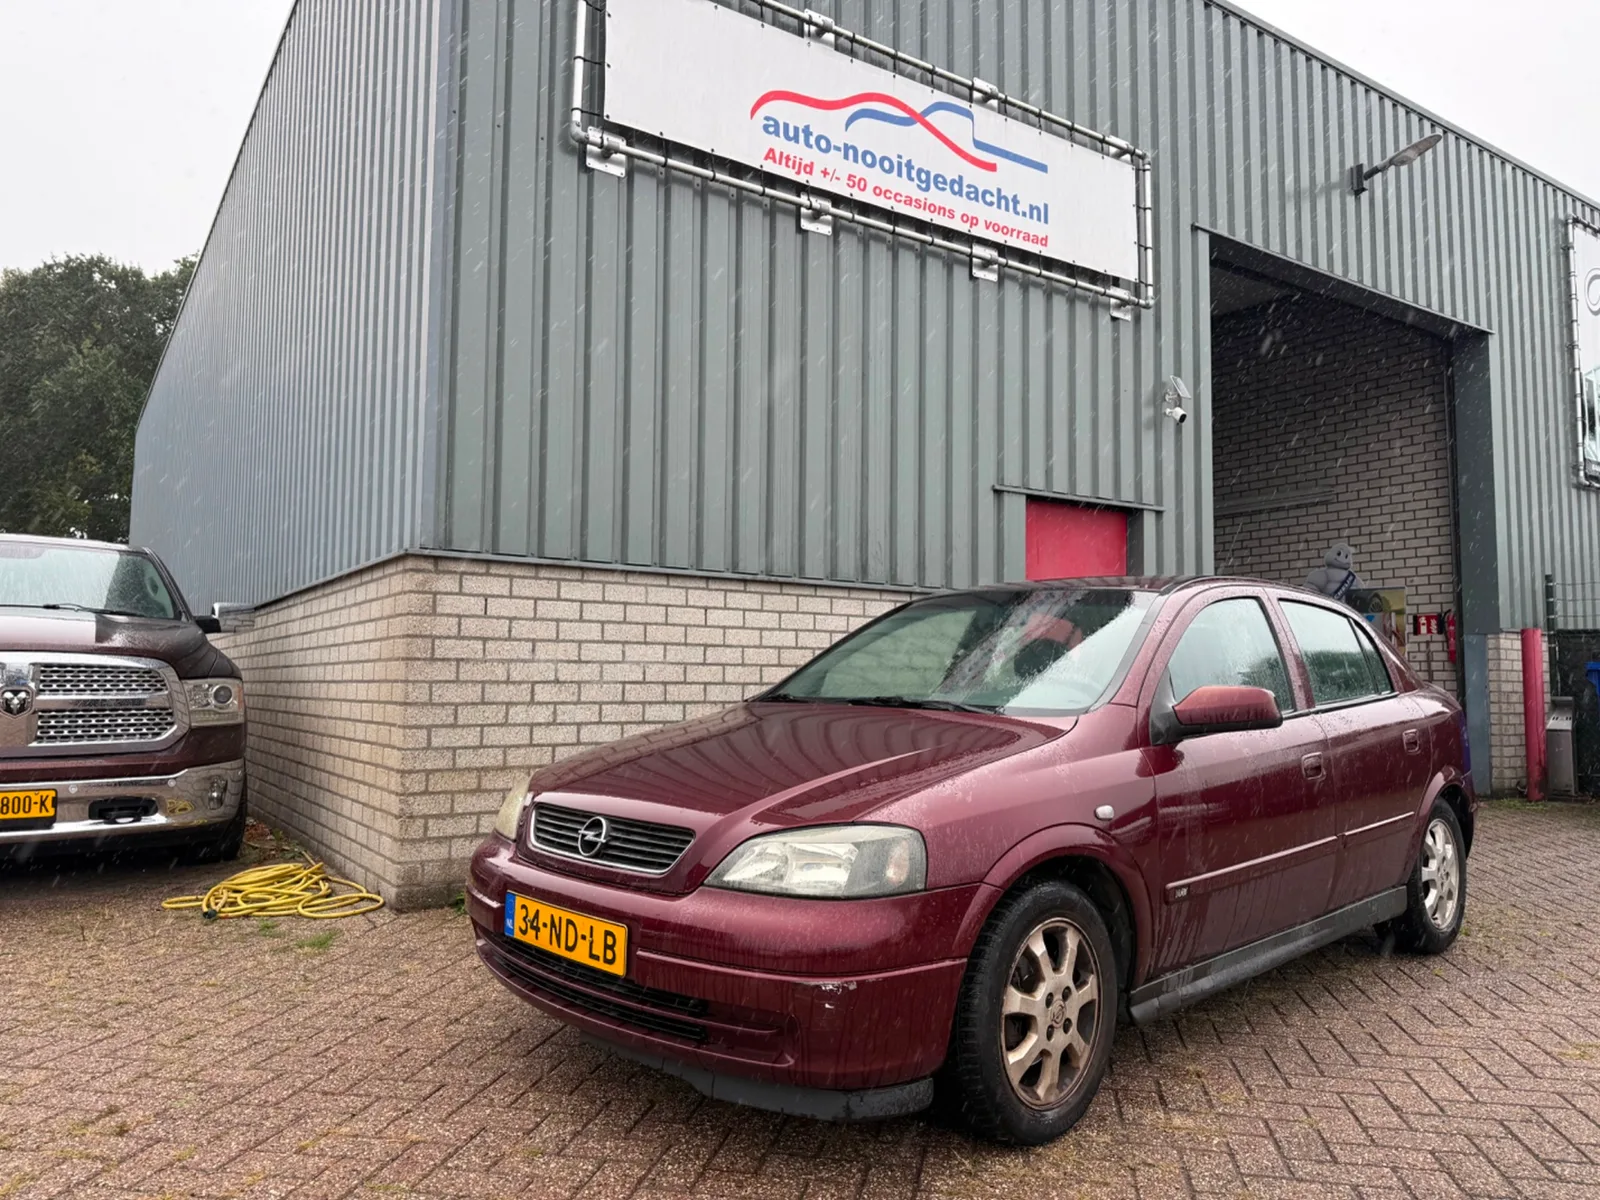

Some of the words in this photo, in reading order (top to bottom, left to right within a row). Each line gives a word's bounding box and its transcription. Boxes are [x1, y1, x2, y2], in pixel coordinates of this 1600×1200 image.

[762, 115, 1048, 224] auto-nooitgedacht.nl
[763, 147, 814, 177] Altijd
[820, 167, 841, 182] +/-
[846, 174, 867, 192] 50
[872, 185, 955, 220] occasions
[960, 212, 979, 229] op
[984, 219, 1048, 248] voorraad
[0, 795, 50, 815] 800-K
[518, 903, 617, 966] 34-ND-LB
